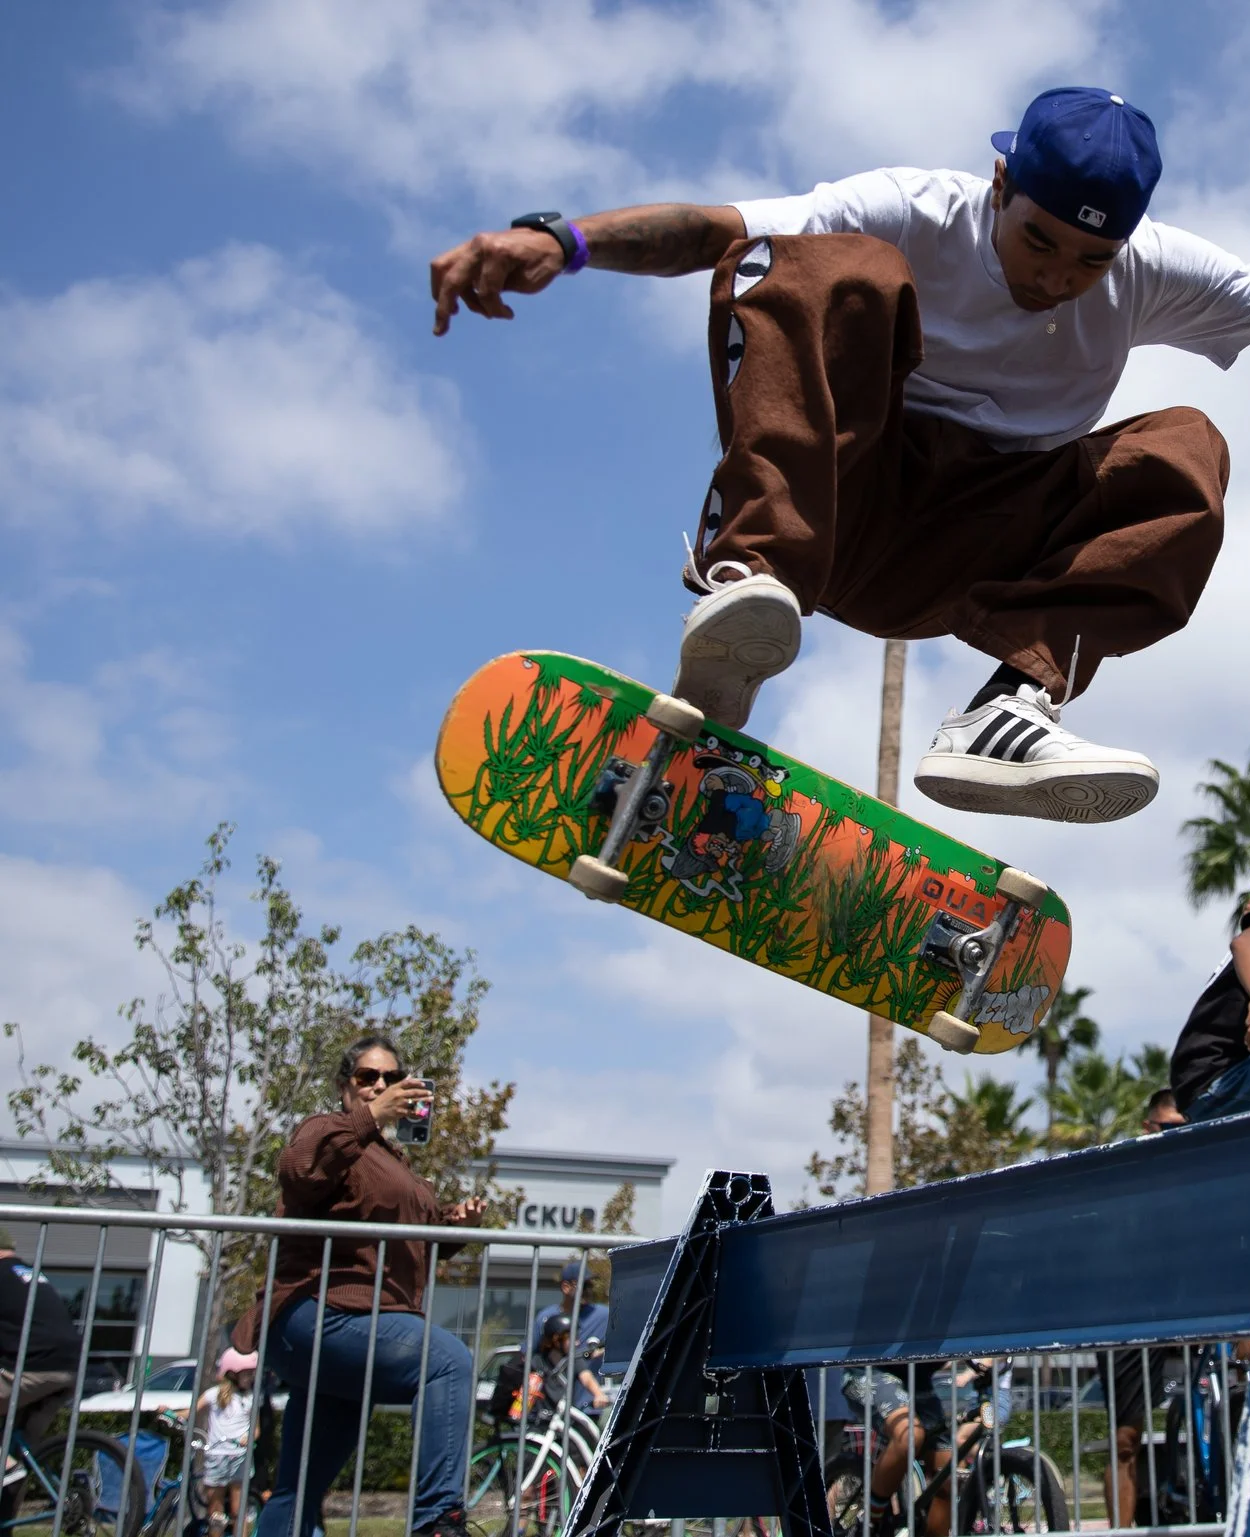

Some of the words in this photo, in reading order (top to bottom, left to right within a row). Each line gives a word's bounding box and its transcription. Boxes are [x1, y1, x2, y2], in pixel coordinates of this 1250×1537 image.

[921, 876, 1021, 940] QUAI
[949, 917, 977, 934] HUNDER
[513, 1204, 596, 1229] ICKUP
